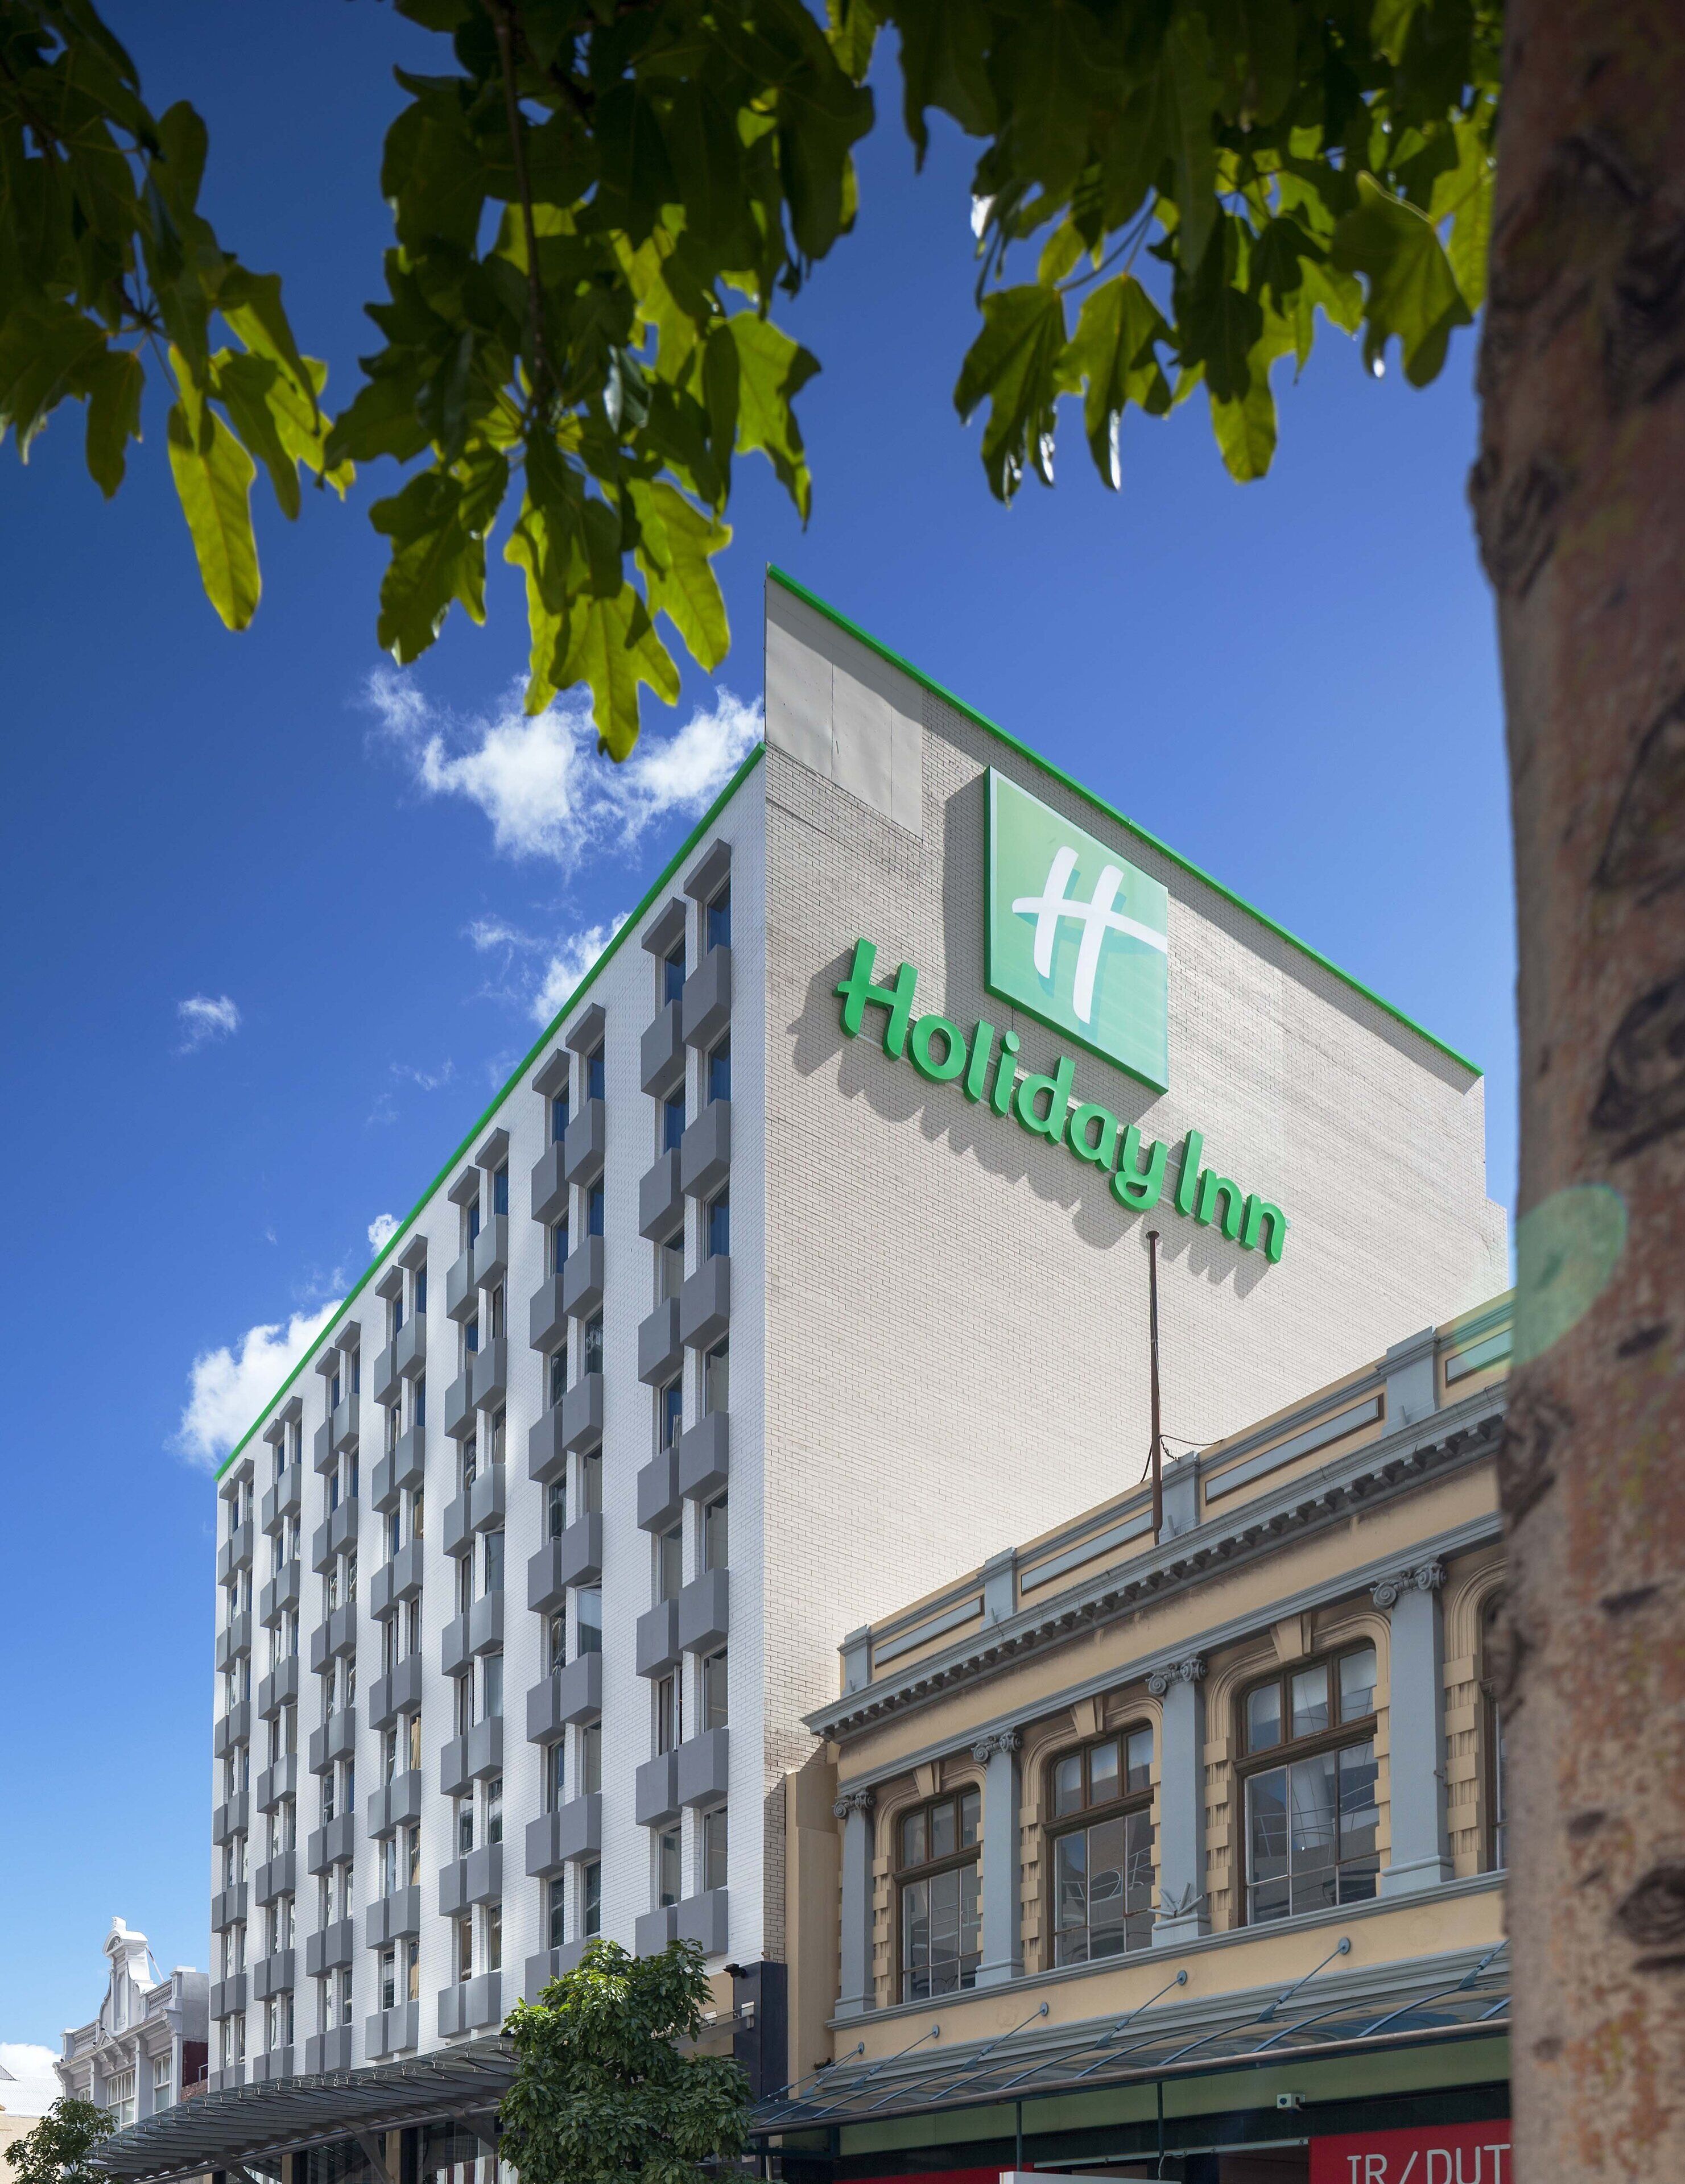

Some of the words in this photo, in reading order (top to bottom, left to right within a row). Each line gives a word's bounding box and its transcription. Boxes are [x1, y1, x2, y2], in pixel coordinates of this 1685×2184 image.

[1013, 846, 1168, 1024] H
[833, 937, 1167, 1212] Holiday
[1174, 1130, 1286, 1264] Inn
[1347, 2144, 1513, 2184] IR/DUT
